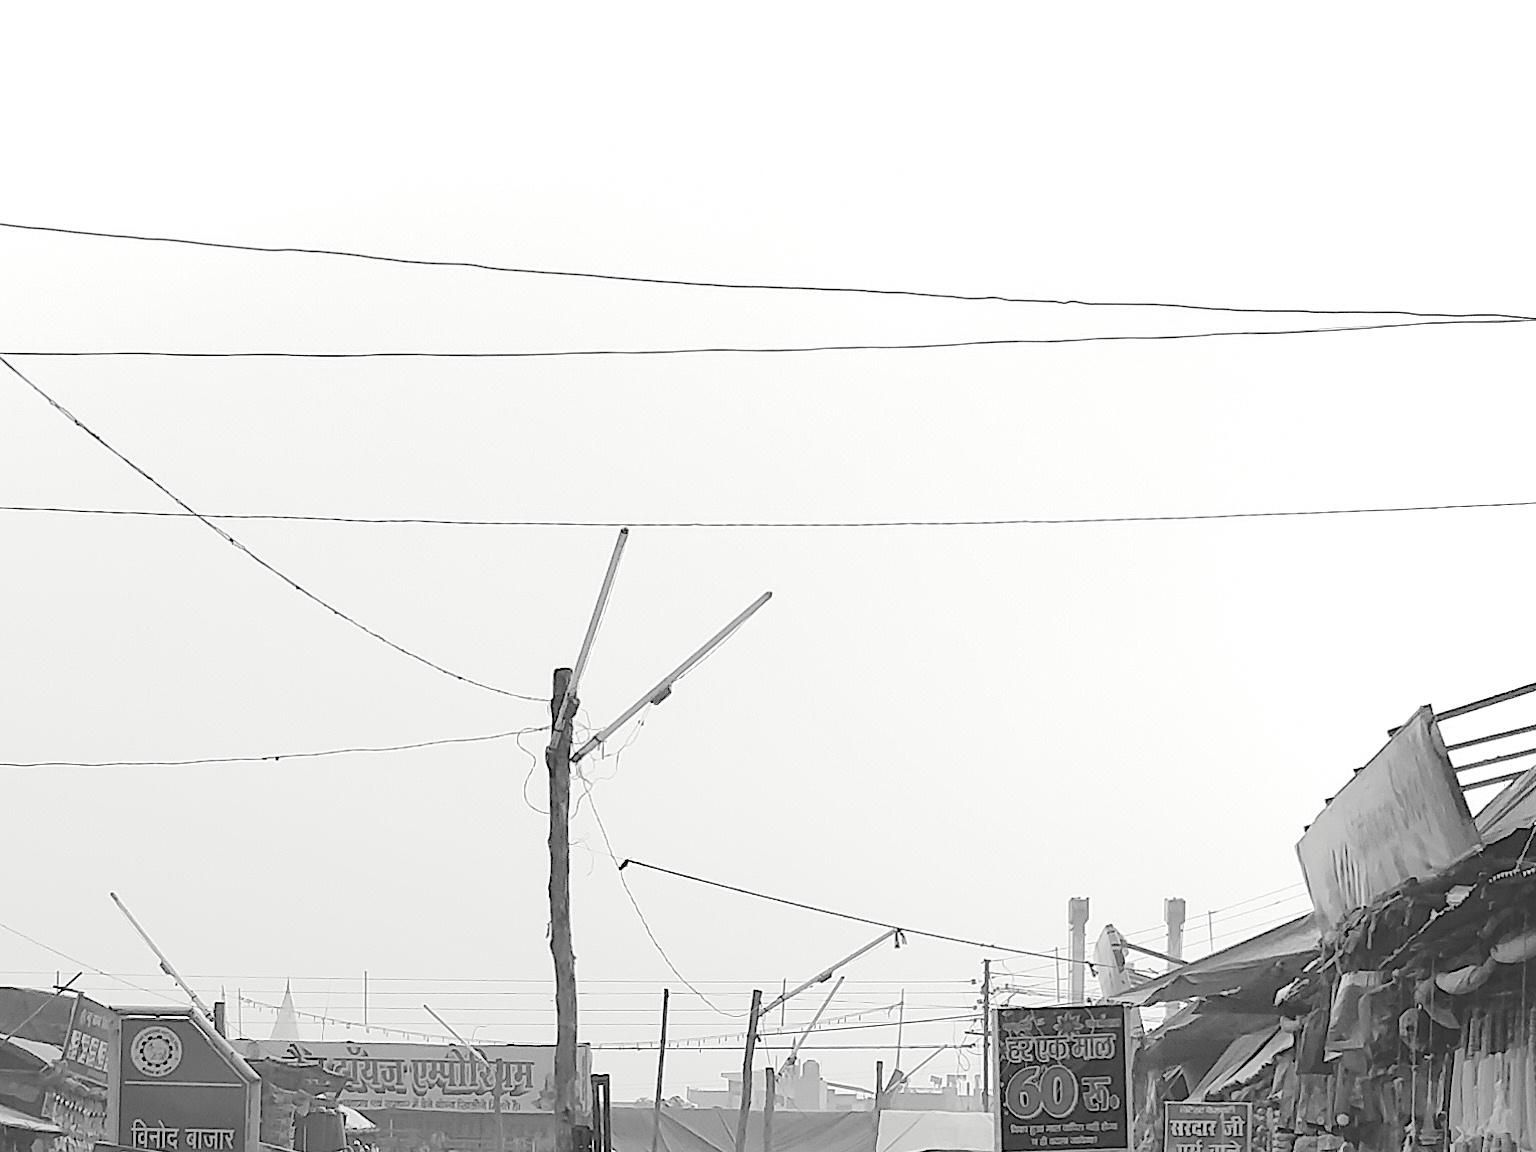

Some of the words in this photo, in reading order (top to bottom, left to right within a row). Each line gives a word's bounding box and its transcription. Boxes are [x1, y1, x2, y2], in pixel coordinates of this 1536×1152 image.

[1072, 1033, 1117, 1060] माल
[1005, 1064, 1079, 1119] 60
[131, 1118, 180, 1150] विनोद
[184, 1128, 235, 1150] बाजार
[1169, 1119, 1217, 1137] सरदार
[1223, 1115, 1246, 1137] जी
